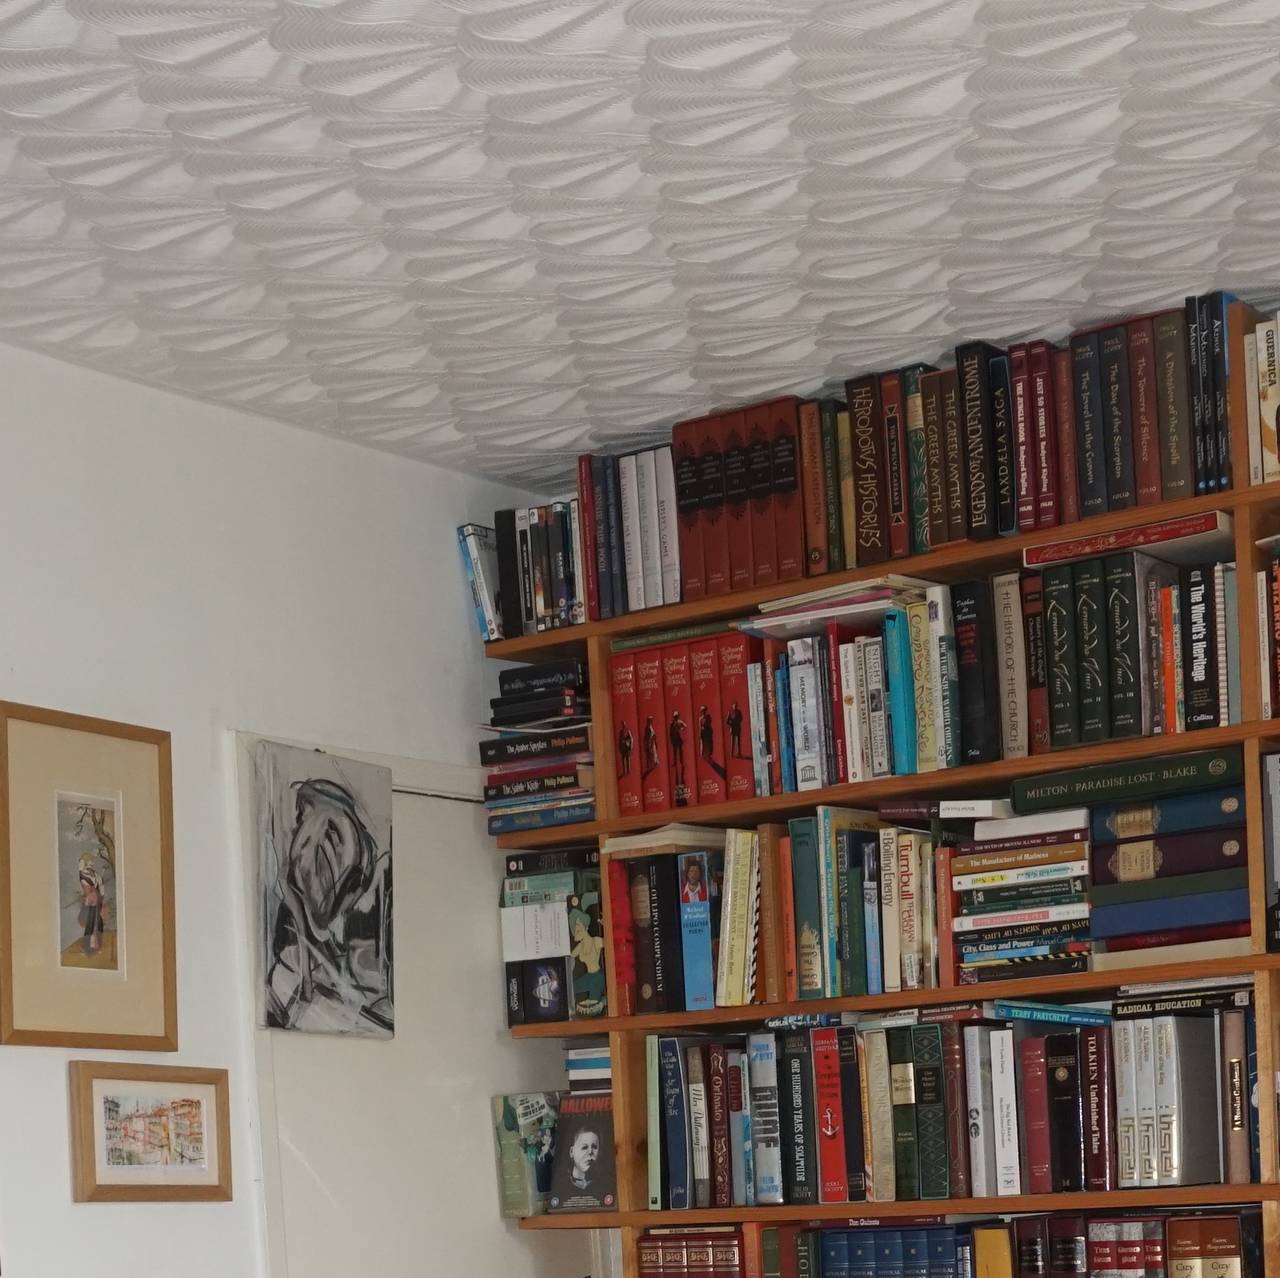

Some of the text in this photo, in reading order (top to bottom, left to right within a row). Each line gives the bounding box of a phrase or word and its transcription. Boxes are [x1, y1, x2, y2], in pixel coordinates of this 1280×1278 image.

[1266, 329, 1277, 386] GUERNICA
[926, 395, 937, 421] THE
[1109, 364, 1122, 478] The Day of the Scorpion
[853, 387, 880, 547] HERODOTVS HISTORIES
[928, 424, 939, 463] GREEK
[945, 390, 961, 523] THE GREEK MYTHS II
[929, 467, 941, 513] MYTHS
[1191, 584, 1207, 681] The World's Heritage
[1026, 765, 1198, 800] MILTON PARADISE LOST BLAKE
[881, 838, 895, 906] Boiling Energy
[653, 927, 663, 991] COMPENDIUM
[1117, 999, 1202, 1015] RADICAL EDUCATION
[690, 1088, 704, 1146] Mrs Dalloway
[711, 1076, 723, 1120] Orlando
[1088, 1035, 1100, 1153] TOLKIEN Unfinished Tales
